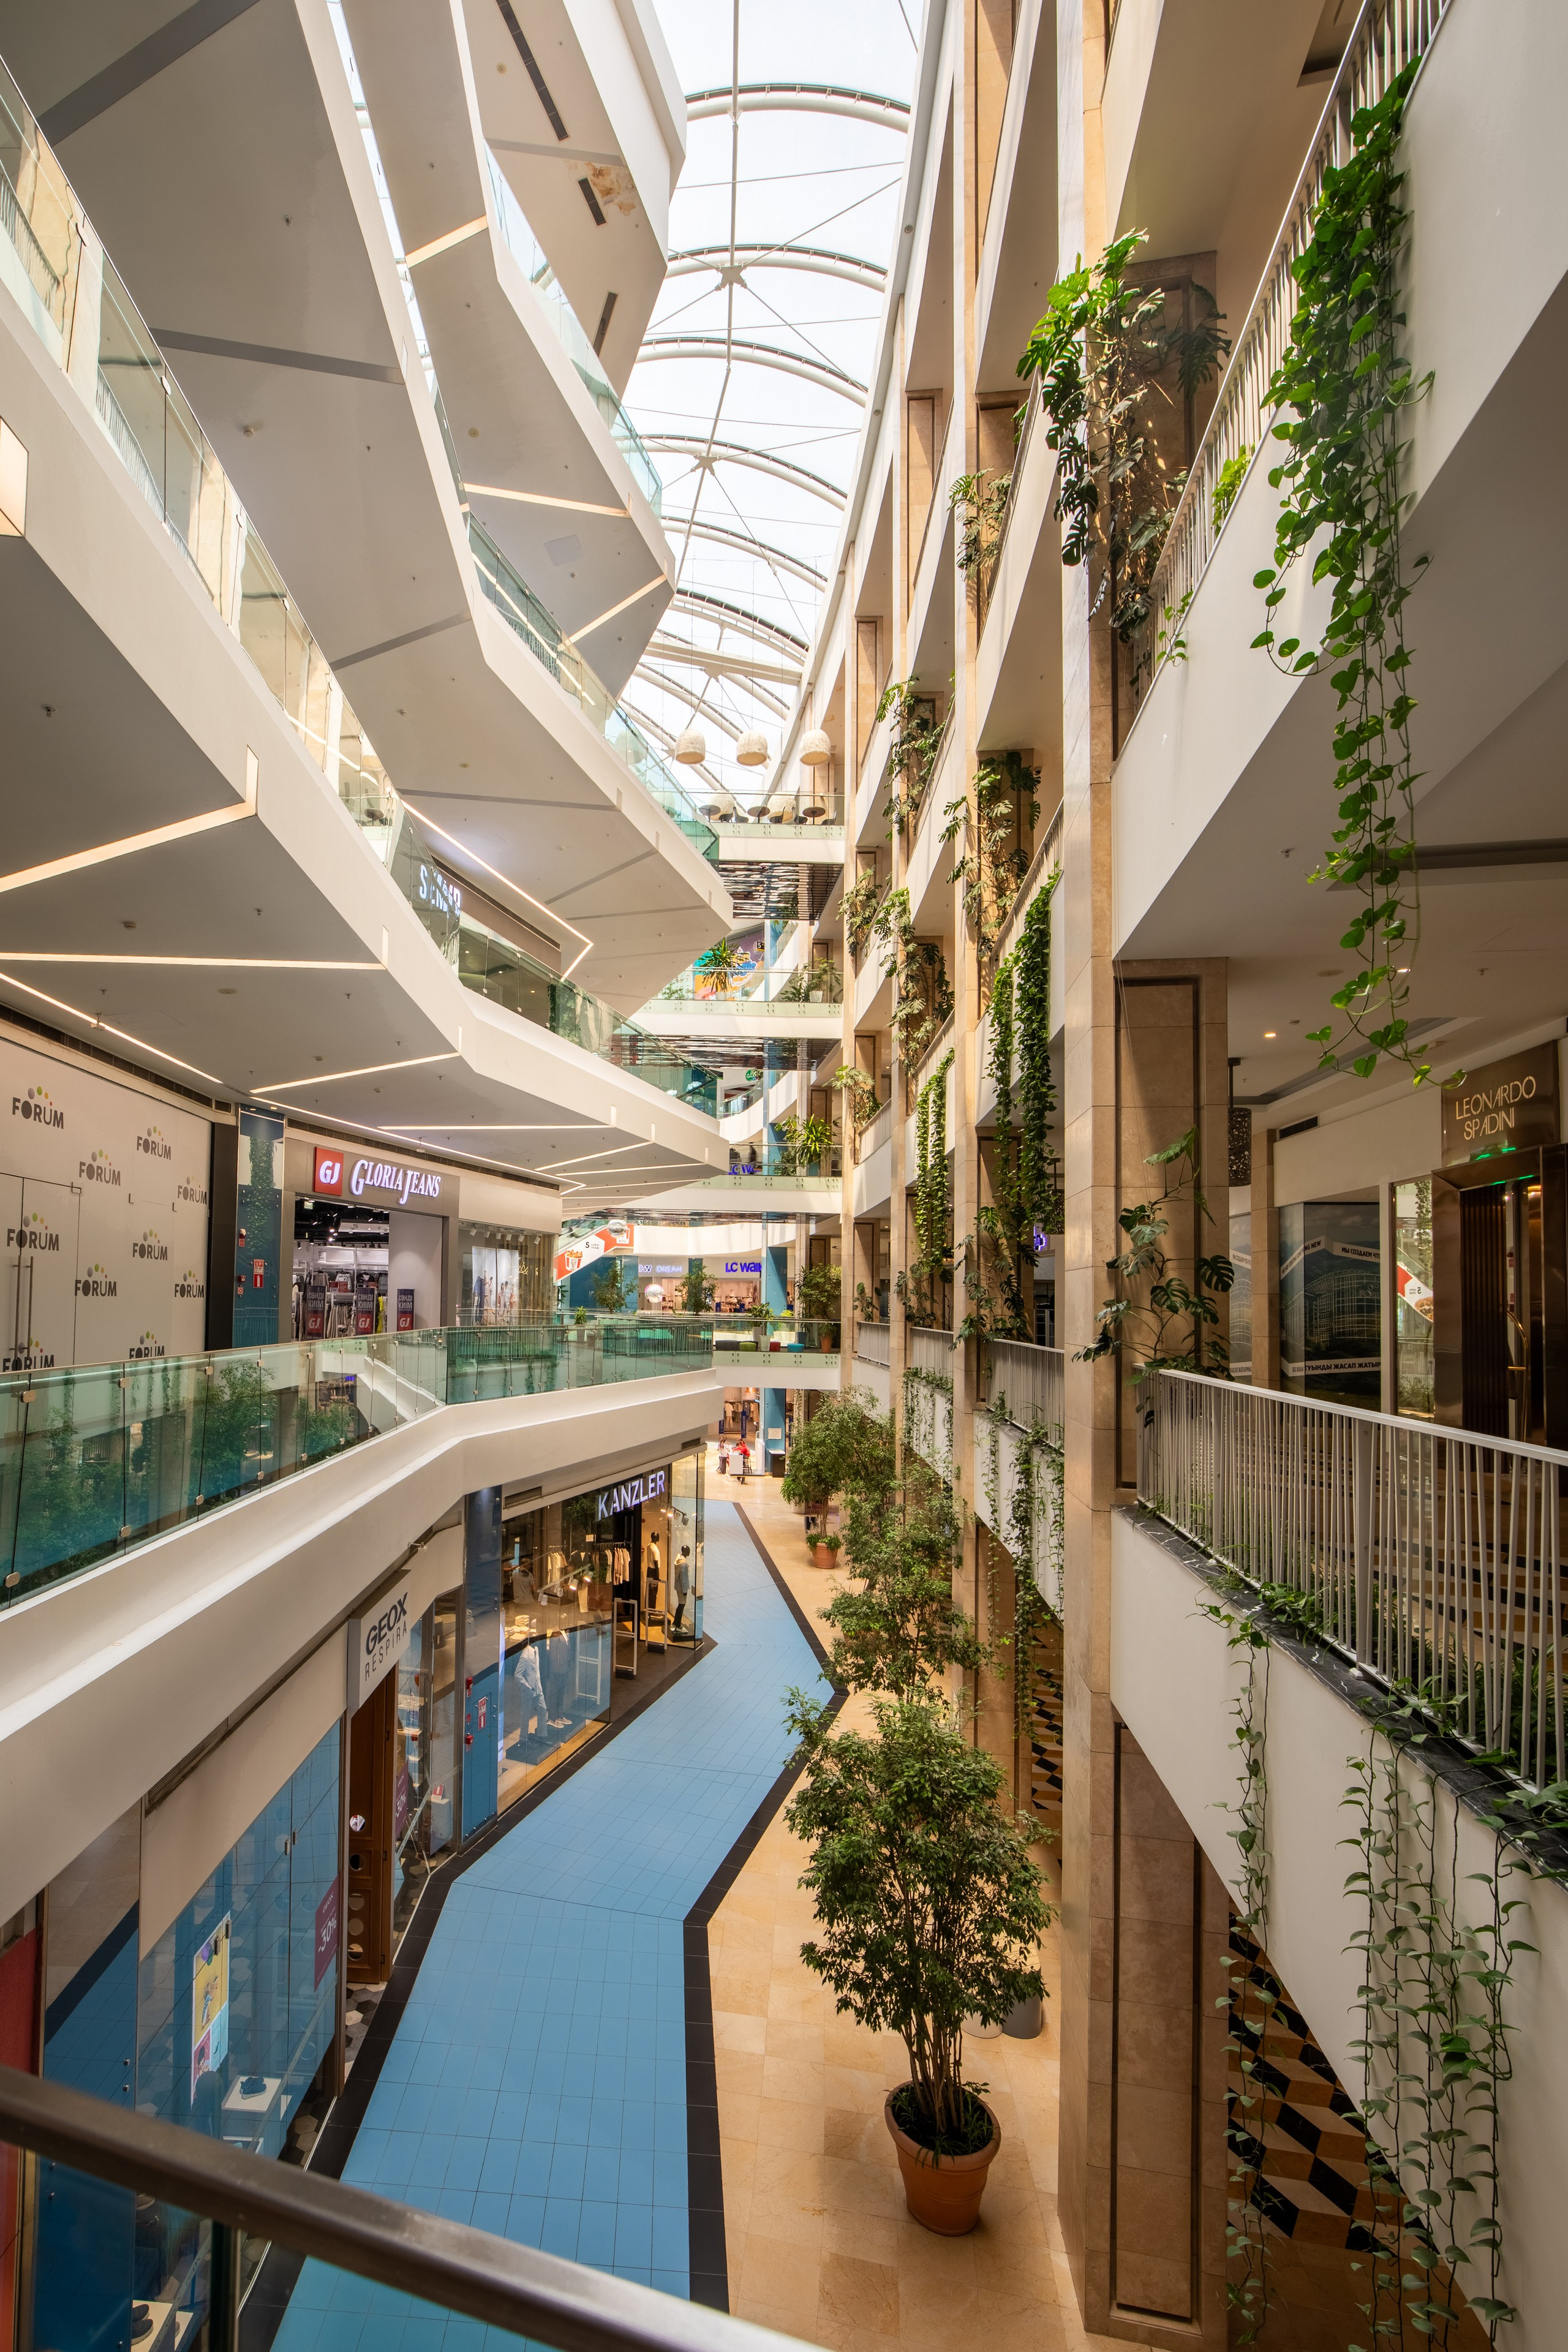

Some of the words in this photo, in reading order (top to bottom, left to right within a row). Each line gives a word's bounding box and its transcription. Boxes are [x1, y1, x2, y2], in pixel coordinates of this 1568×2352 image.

[1455, 1076, 1536, 1120] LEONARDO
[12, 1096, 64, 1129] FORUM
[1463, 1107, 1515, 1140] SPADINI
[137, 1135, 172, 1161] FORUM
[79, 1161, 121, 1186] FORUM
[319, 1160, 341, 1185] GJ
[350, 1159, 403, 1196] GLORIA
[399, 1170, 442, 1205] JEANS
[177, 1184, 208, 1205] FORUM
[7, 1228, 60, 1251] FORUM
[1311, 1240, 1321, 1249] NEW
[132, 1242, 168, 1261] FORUM
[1350, 1248, 1372, 1257] СОЗДАЕМ
[656, 1265, 683, 1273] DREAM
[725, 1262, 738, 1273] LC
[74, 1279, 118, 1297] FORUM
[174, 1283, 205, 1298] FORUM
[307, 1300, 324, 1308] КИІМ
[309, 1317, 320, 1329] GJ
[358, 1317, 370, 1329] GJ
[399, 1317, 410, 1327] GJ
[598, 1470, 665, 1521] KANZLER
[366, 1591, 409, 1655] GEOX
[365, 1619, 407, 1681] RESPIRA
[322, 1891, 334, 1913] GEOX
[318, 1912, 337, 1953] -30%
